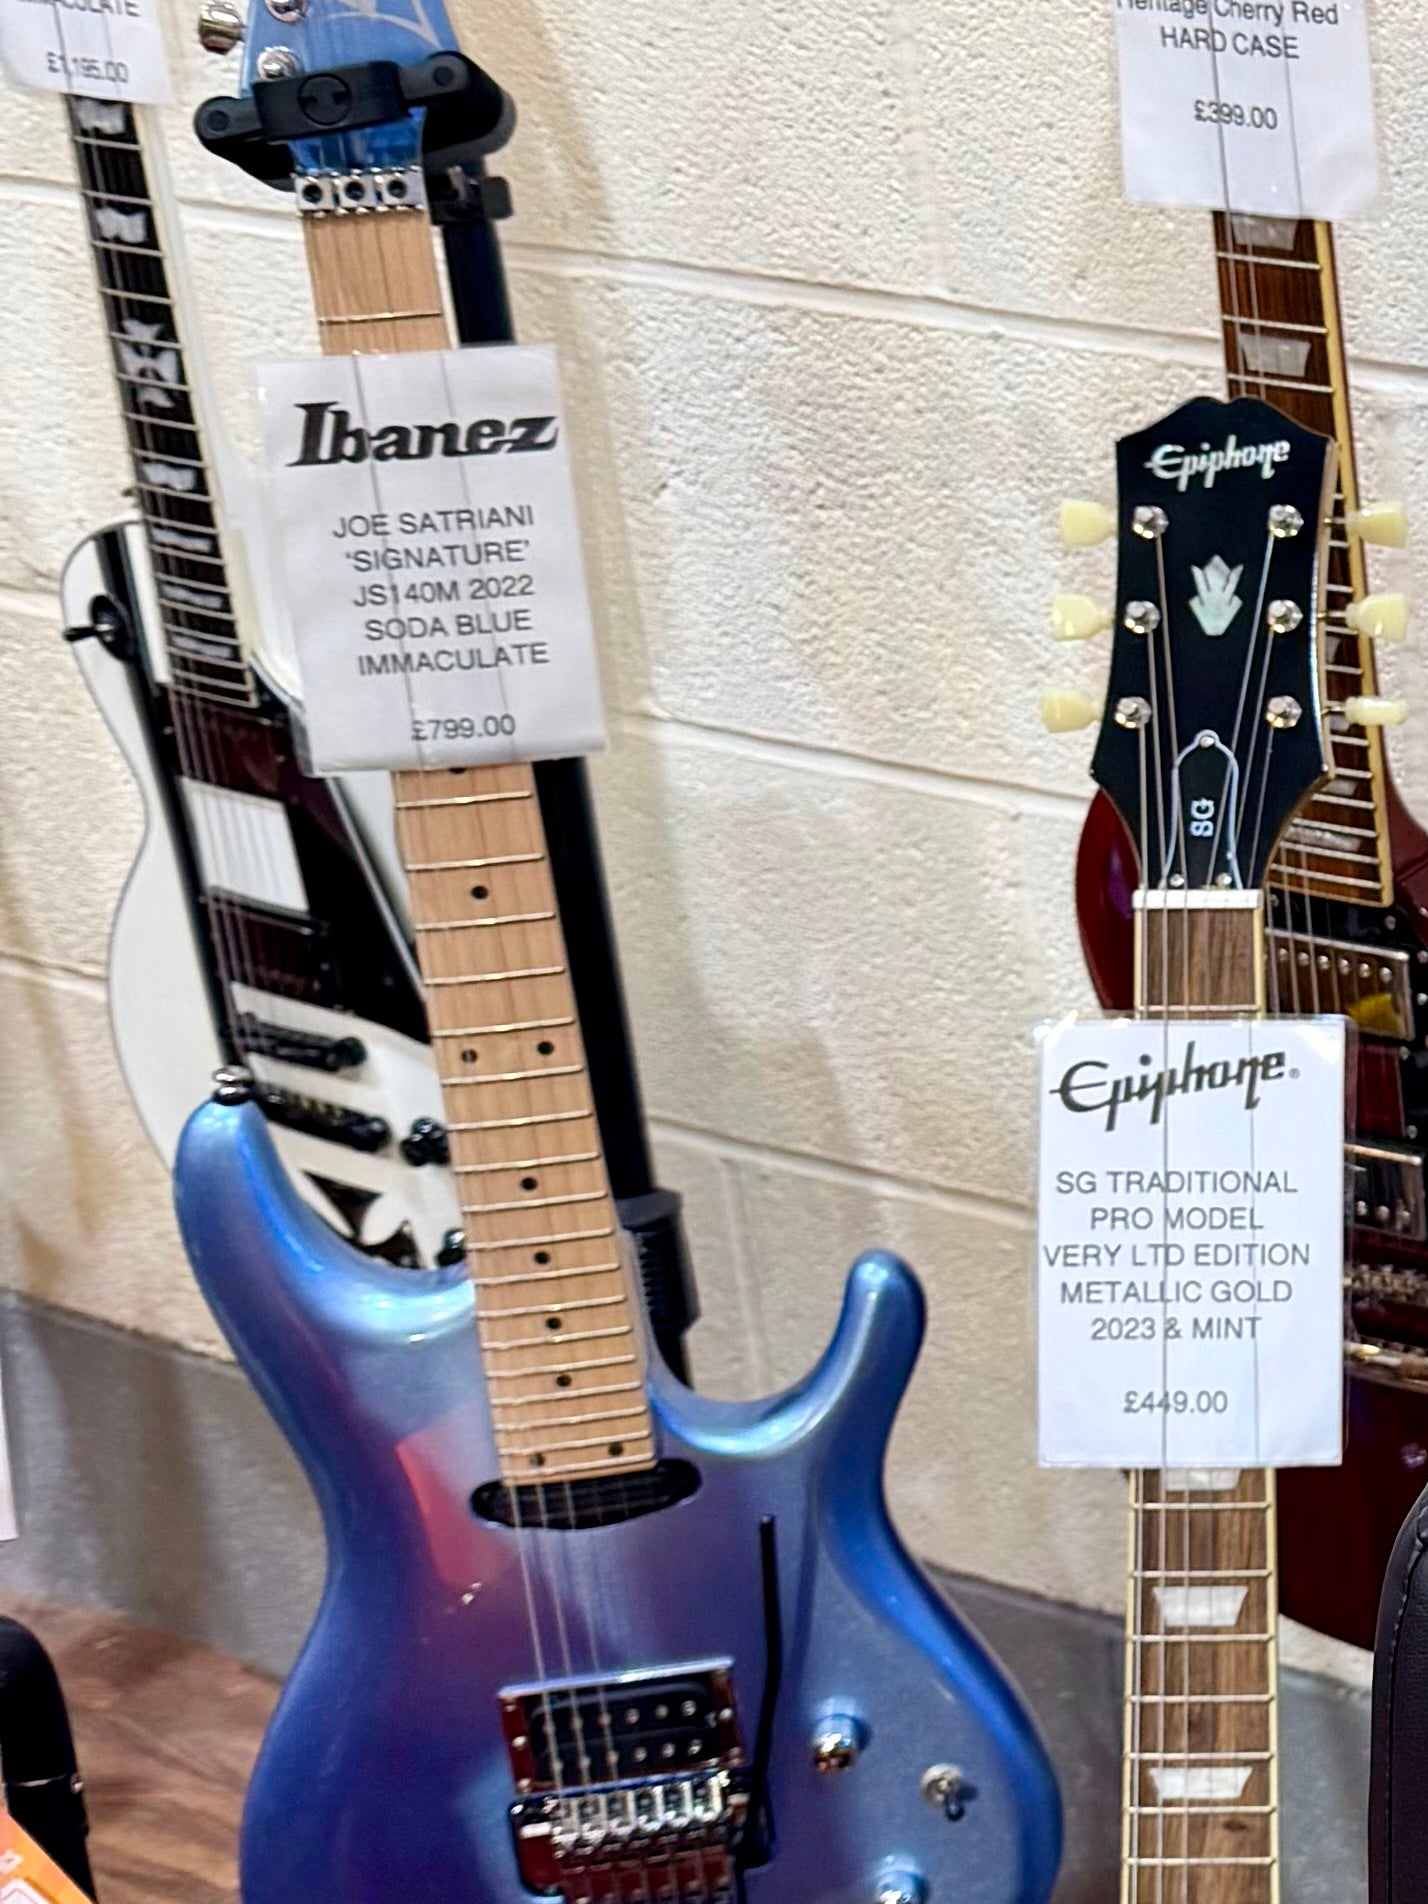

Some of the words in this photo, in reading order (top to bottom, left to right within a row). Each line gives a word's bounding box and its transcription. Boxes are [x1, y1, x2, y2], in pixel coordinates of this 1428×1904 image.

[1292, 1, 1339, 26] Red
[1161, 26, 1227, 52] HARD
[1232, 34, 1300, 59] CASE
[1194, 99, 1278, 130] £399.00
[286, 401, 560, 468] Ibanez
[1144, 434, 1292, 492] Epiphone
[332, 514, 391, 539] JOE
[399, 505, 535, 536] SATRIANI
[353, 580, 461, 608] JS140M
[469, 575, 535, 600] 2022
[364, 617, 447, 642] SODA
[457, 609, 533, 635] BLUE
[358, 641, 550, 677] IMMACULATE
[411, 713, 517, 742] £799.00
[1189, 798, 1216, 838] SG
[1049, 1041, 1286, 1132] Epiphone
[1056, 1171, 1097, 1195] SG
[1106, 1169, 1299, 1194] TRADITIONAL
[1090, 1208, 1153, 1231] PRO
[1164, 1207, 1264, 1231] MODEL
[1043, 1245, 1122, 1267] VERY
[1132, 1244, 1185, 1267] LTD
[1194, 1243, 1311, 1267] EDITION
[1061, 1281, 1203, 1304] METALLIC
[1211, 1280, 1293, 1303] GOLD
[1091, 1317, 1156, 1341] 2023
[1164, 1317, 1183, 1341] &
[1192, 1317, 1263, 1340] MINT
[1123, 1390, 1228, 1415] £449.00
